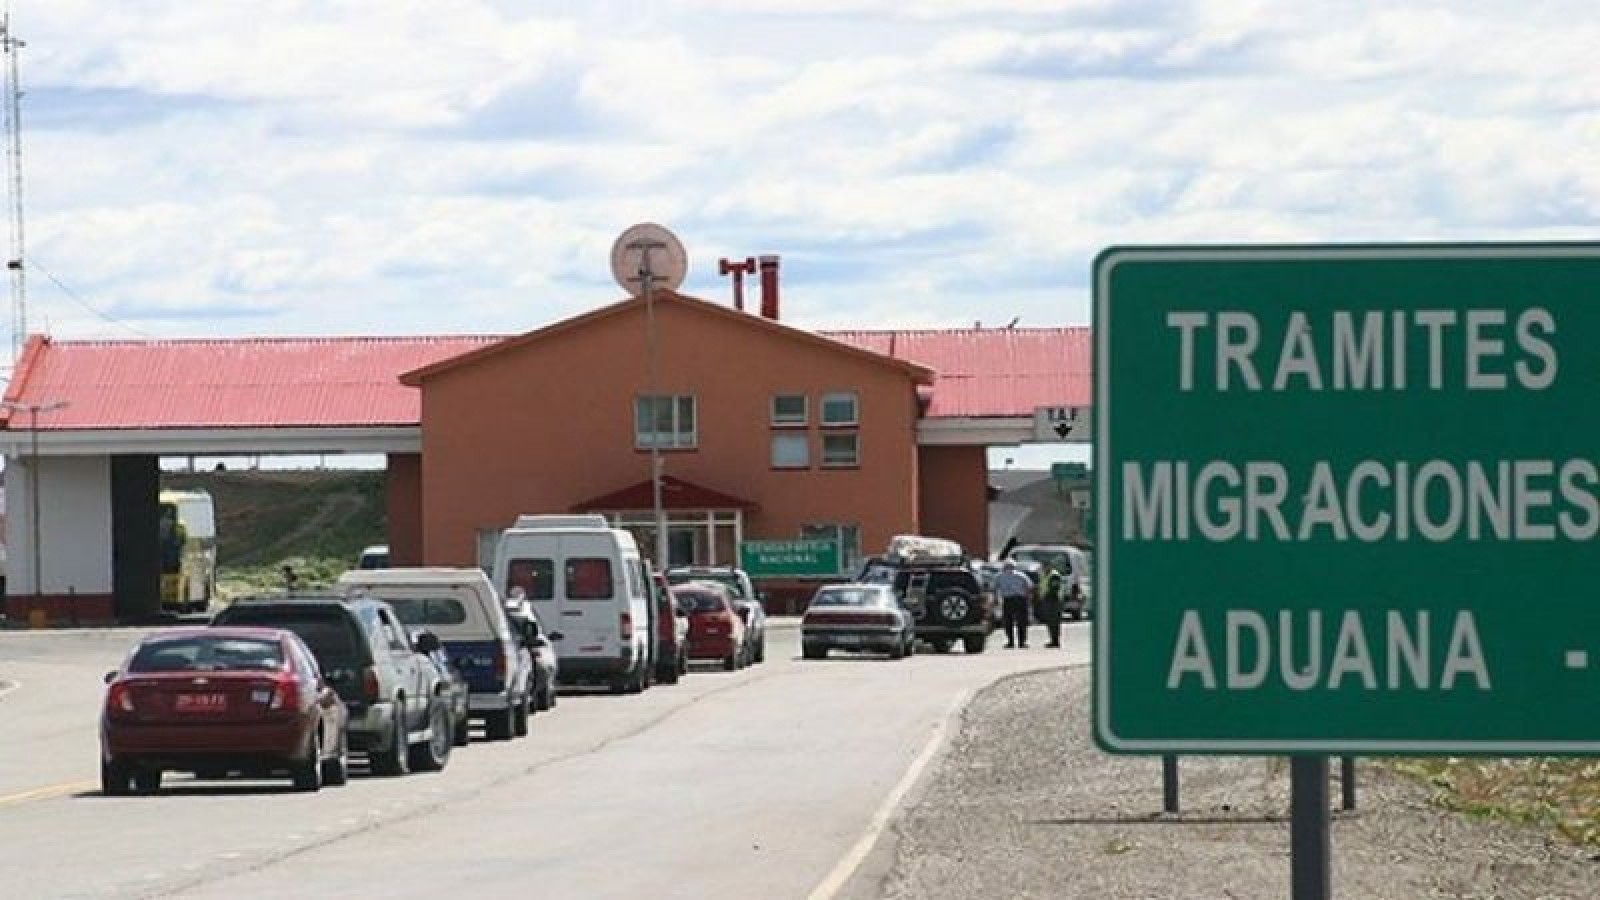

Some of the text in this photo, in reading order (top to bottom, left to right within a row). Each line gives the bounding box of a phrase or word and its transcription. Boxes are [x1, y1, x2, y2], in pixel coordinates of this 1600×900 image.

[1166, 308, 1559, 391] TRAMITES
[1122, 458, 1600, 541] MIGRACIONES
[1166, 609, 1492, 691] ADUANA
